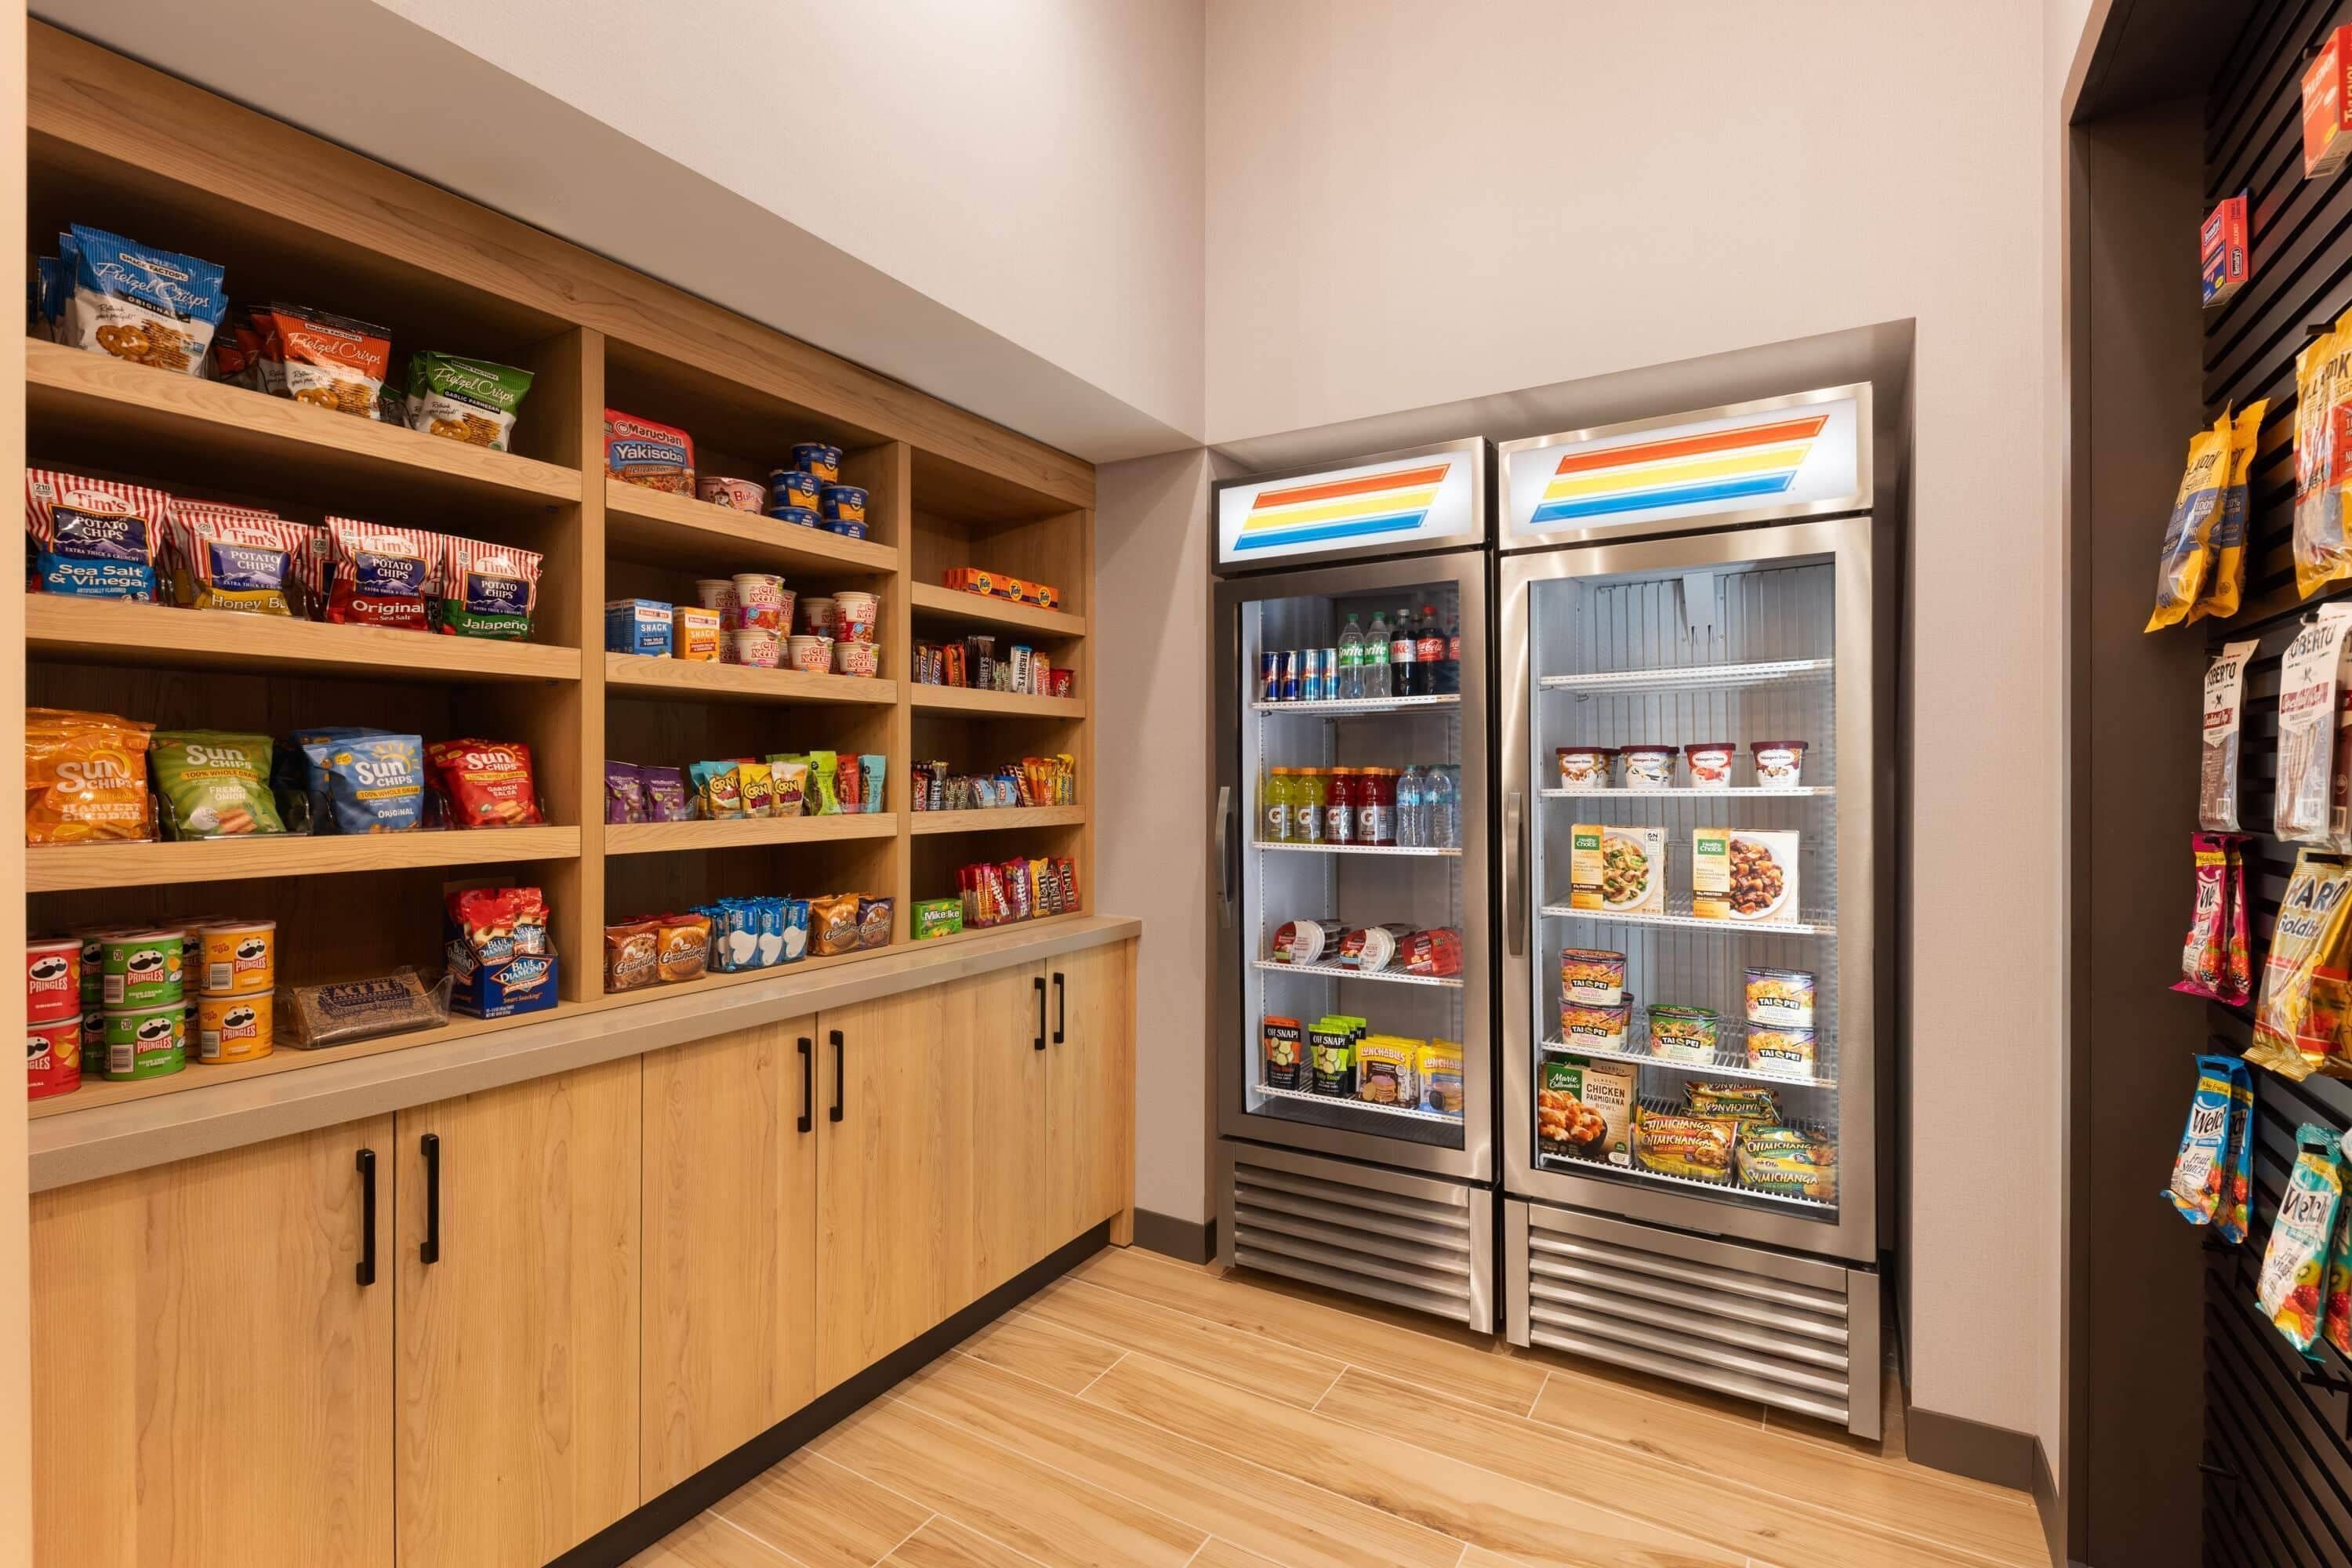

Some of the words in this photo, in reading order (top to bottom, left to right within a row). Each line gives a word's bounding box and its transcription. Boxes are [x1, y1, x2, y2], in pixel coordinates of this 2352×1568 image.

[121, 254, 147, 269] SNACK
[149, 265, 188, 281] FACTORY
[93, 263, 156, 293] Pretzel
[156, 281, 210, 309] Crisps
[288, 332, 339, 356] Pretzel
[339, 343, 381, 365] Crisps
[434, 368, 477, 391] Pretzel
[477, 381, 515, 404] Crisps
[445, 390, 467, 402] GARLIC
[469, 397, 500, 414] PARMESAN
[628, 423, 683, 446] Maruchan
[615, 444, 684, 463] Yakisoba
[73, 492, 127, 513] Tim's
[75, 516, 129, 531] POTATO
[82, 527, 125, 540] CHIPS
[228, 529, 278, 547] Tim's
[369, 537, 412, 554] Tim's
[231, 550, 282, 565] POTATO
[372, 557, 414, 572] POTATO
[59, 564, 98, 575] Sea
[103, 565, 144, 577] Salt
[237, 561, 276, 572] CHIPS
[377, 568, 409, 579] CHIPS
[480, 559, 517, 575] Tim's
[48, 572, 67, 584] &
[71, 575, 149, 588] Vinegar
[481, 580, 517, 592] POTATO
[979, 578, 992, 590] Tide
[485, 589, 514, 599] CHIPS
[212, 593, 262, 611] Honey
[352, 600, 425, 615] Original
[463, 619, 528, 631] Jalapeño
[641, 623, 667, 632] SNACK
[690, 630, 716, 638] SNACK
[1339, 644, 1363, 659] Sprite
[1365, 644, 1386, 655] prite
[186, 745, 245, 766] Sun
[466, 753, 511, 770] Sun
[209, 760, 252, 770] CHIPS
[485, 763, 518, 771] CHIPS
[56, 760, 132, 793] Sun
[238, 771, 259, 779] GRAIN
[355, 761, 405, 785] Sun
[86, 778, 132, 790] CHIPS
[376, 775, 413, 787] CHIPS
[710, 777, 739, 793] CORN
[773, 779, 798, 795] CORN
[215, 792, 246, 800] ONION
[743, 784, 771, 799] CORN
[378, 808, 414, 819] ORIGINAL
[1015, 866, 1029, 916] Skittles
[924, 909, 946, 921] Mike
[947, 909, 960, 919] Ike
[487, 938, 507, 949] BLUE
[235, 956, 267, 973] PRINGLES
[499, 961, 547, 982] DIAMOND
[512, 959, 535, 972] BLUE
[127, 969, 164, 985] PRINGLES
[29, 978, 69, 994] PRINGLES
[1784, 1000, 1799, 1009] PEI
[222, 1025, 256, 1040] PRINGLES
[1276, 1029, 1298, 1039] SNAP!
[1593, 1028, 1607, 1036] PEI
[137, 1036, 172, 1054] PRINGLES
[1313, 1035, 1323, 1044] OH
[1323, 1036, 1346, 1046] SNAP!
[1686, 1039, 1700, 1048] PEI
[1360, 1047, 1406, 1063] LUNCHABLES
[1785, 1051, 1801, 1062] PEI
[1424, 1057, 1462, 1071] LUNCHAB
[1549, 1073, 1578, 1083] Marie
[1586, 1083, 1625, 1098] CHICKEN
[1586, 1093, 1624, 1106] PARMIGIANA
[1706, 1102, 1758, 1112] IMICHANGA
[2193, 1106, 2227, 1134] Welc
[2282, 1185, 2330, 1224] Welch
